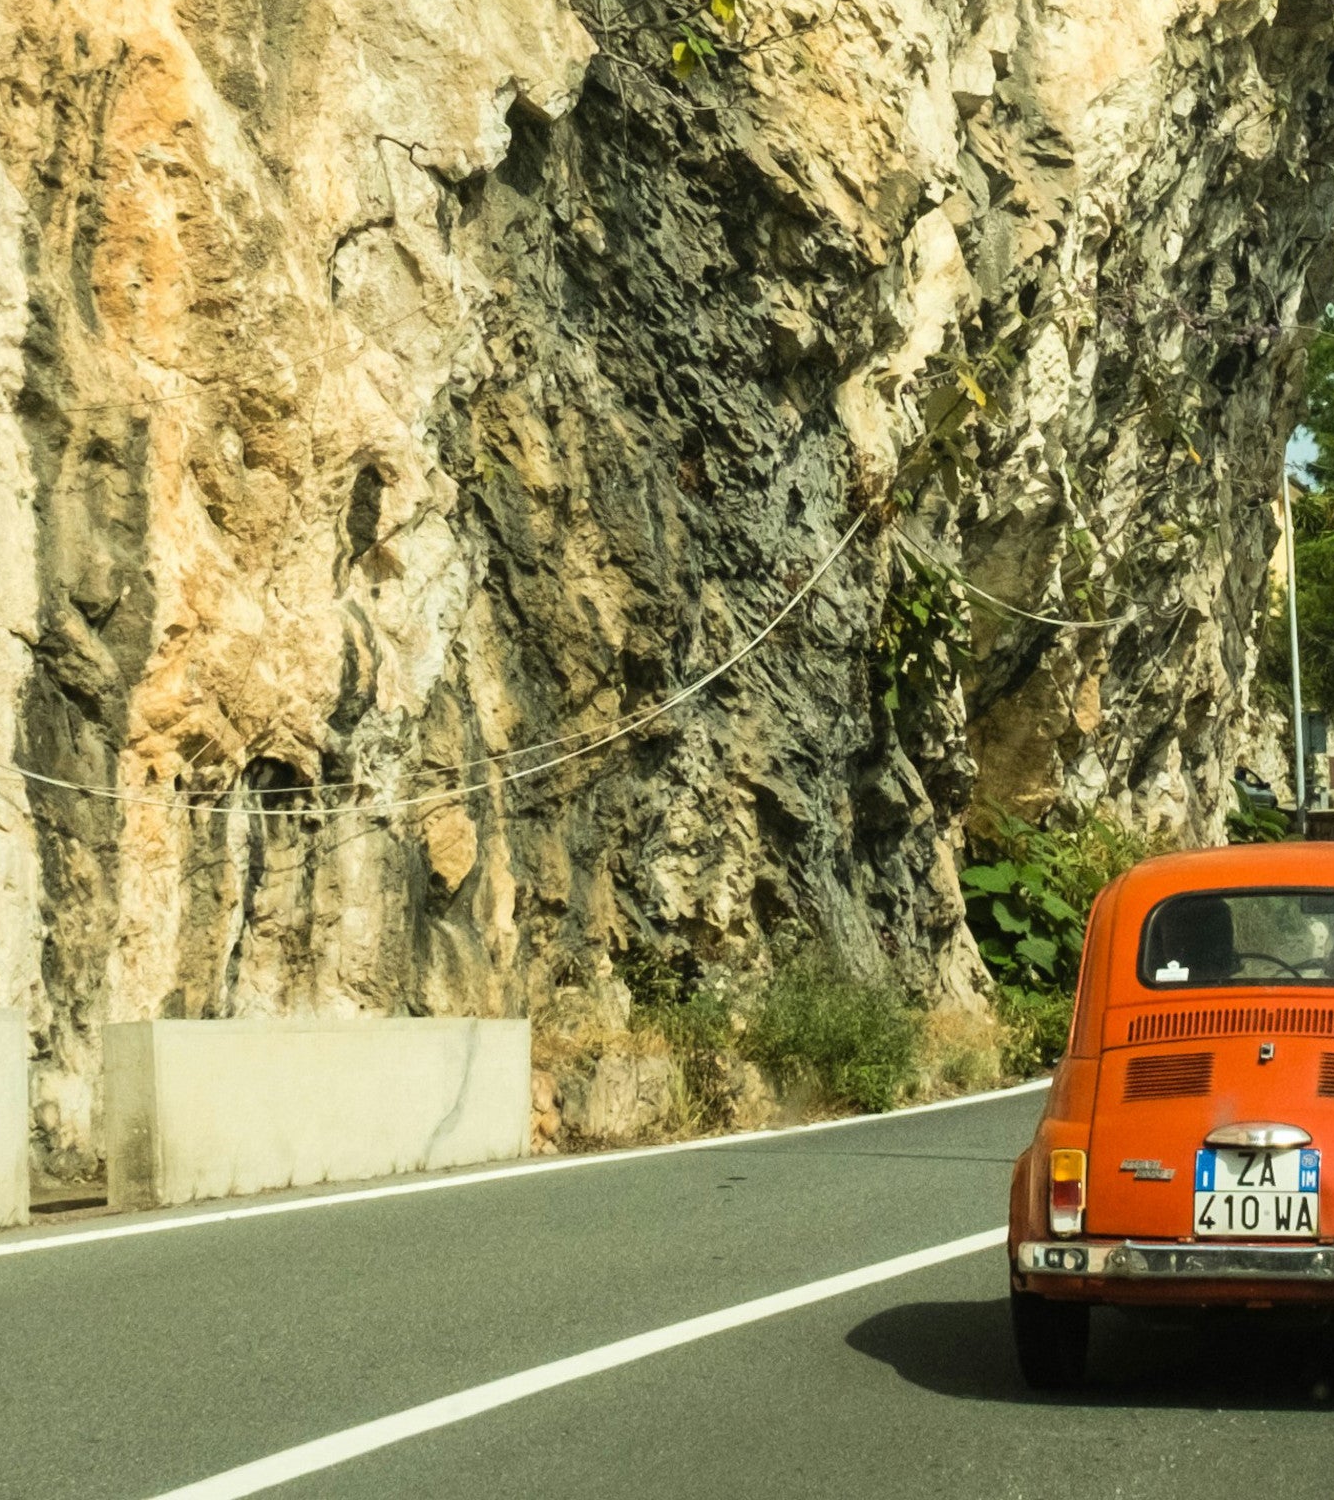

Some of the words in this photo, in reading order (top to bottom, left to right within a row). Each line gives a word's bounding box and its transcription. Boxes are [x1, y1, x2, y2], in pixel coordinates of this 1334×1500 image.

[1236, 1151, 1276, 1187] ZA
[1301, 1170, 1317, 1188] IM
[1197, 1194, 1260, 1230] 410
[1274, 1195, 1314, 1231] WA
